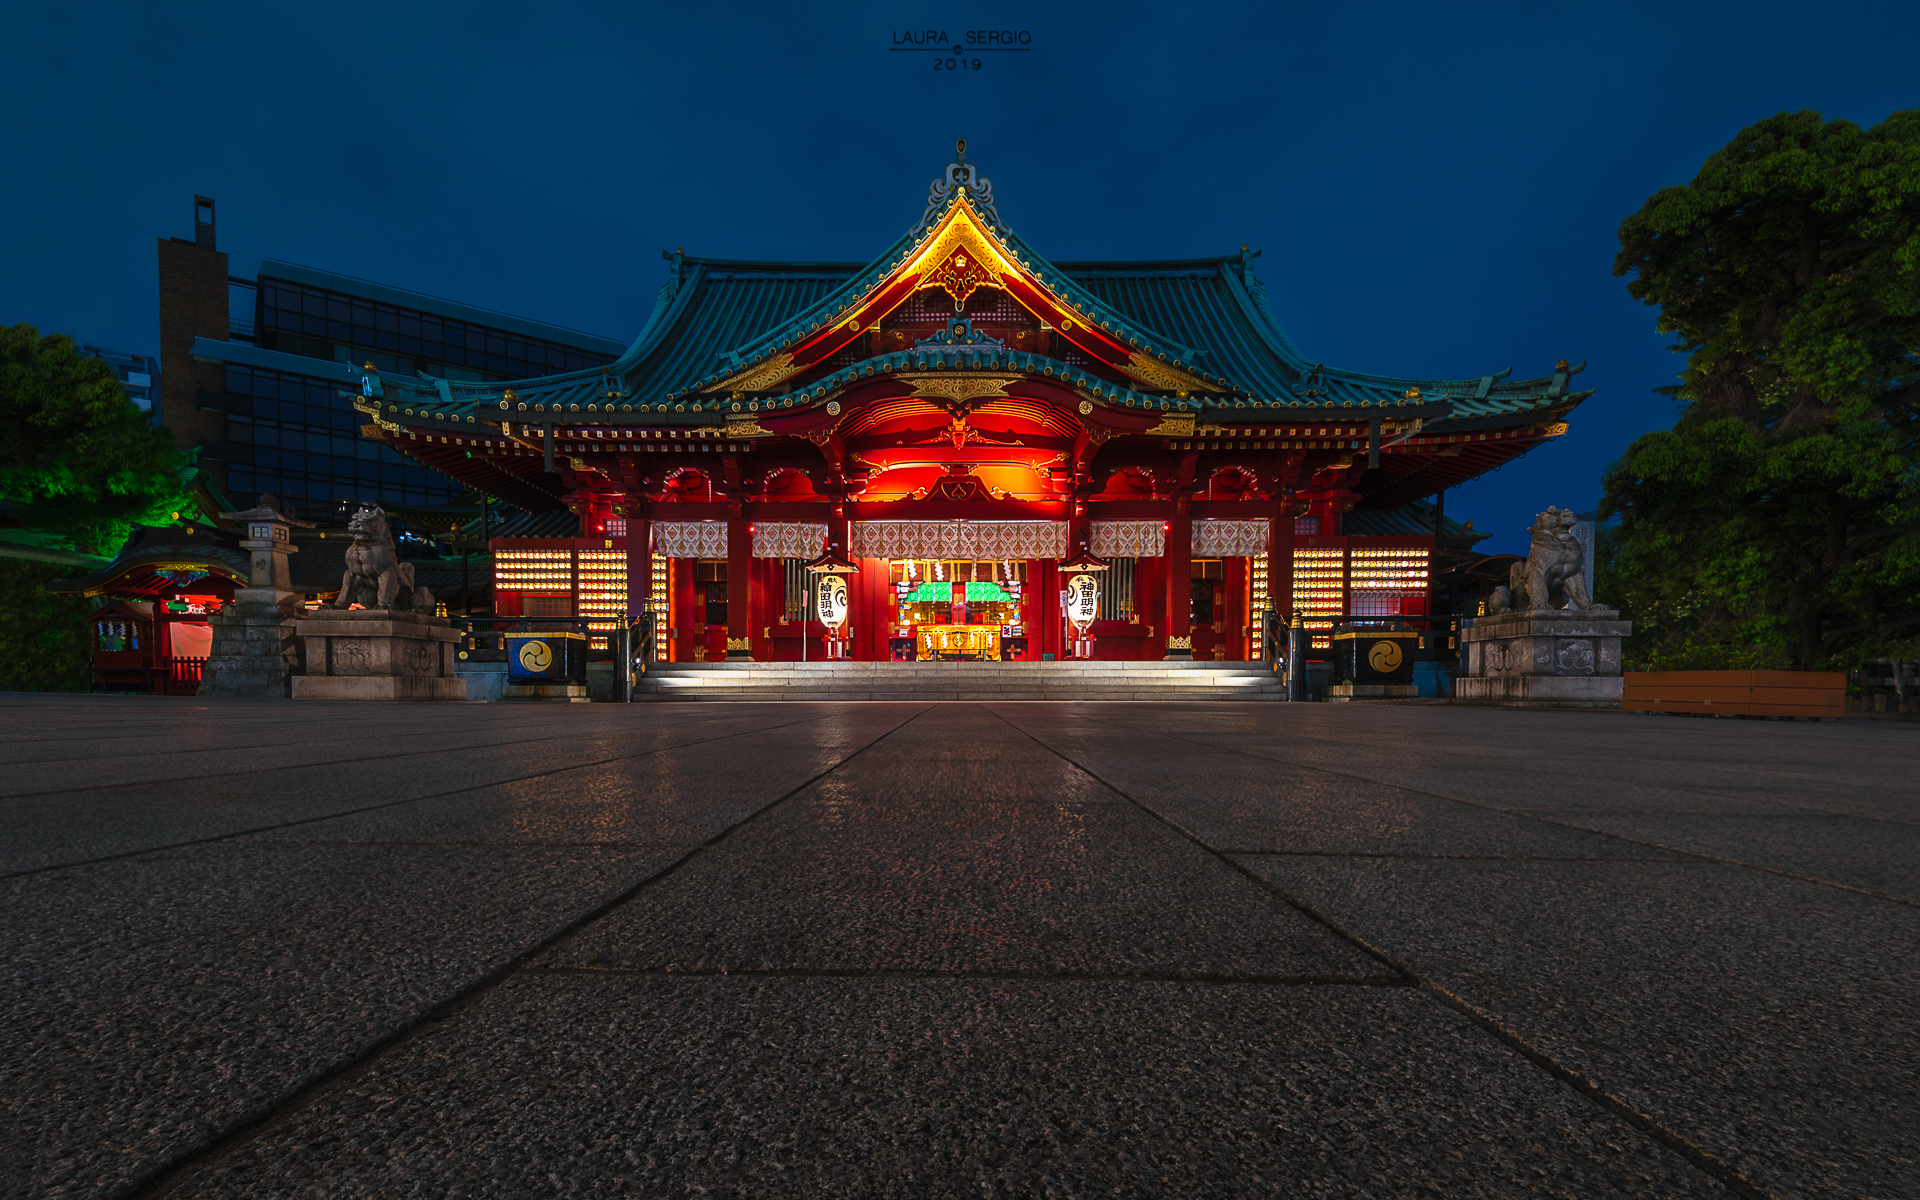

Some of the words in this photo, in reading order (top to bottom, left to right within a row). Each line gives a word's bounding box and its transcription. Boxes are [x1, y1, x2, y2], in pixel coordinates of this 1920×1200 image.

[820, 582, 835, 618] 神田明神
[1079, 581, 1094, 615] 神田明神
